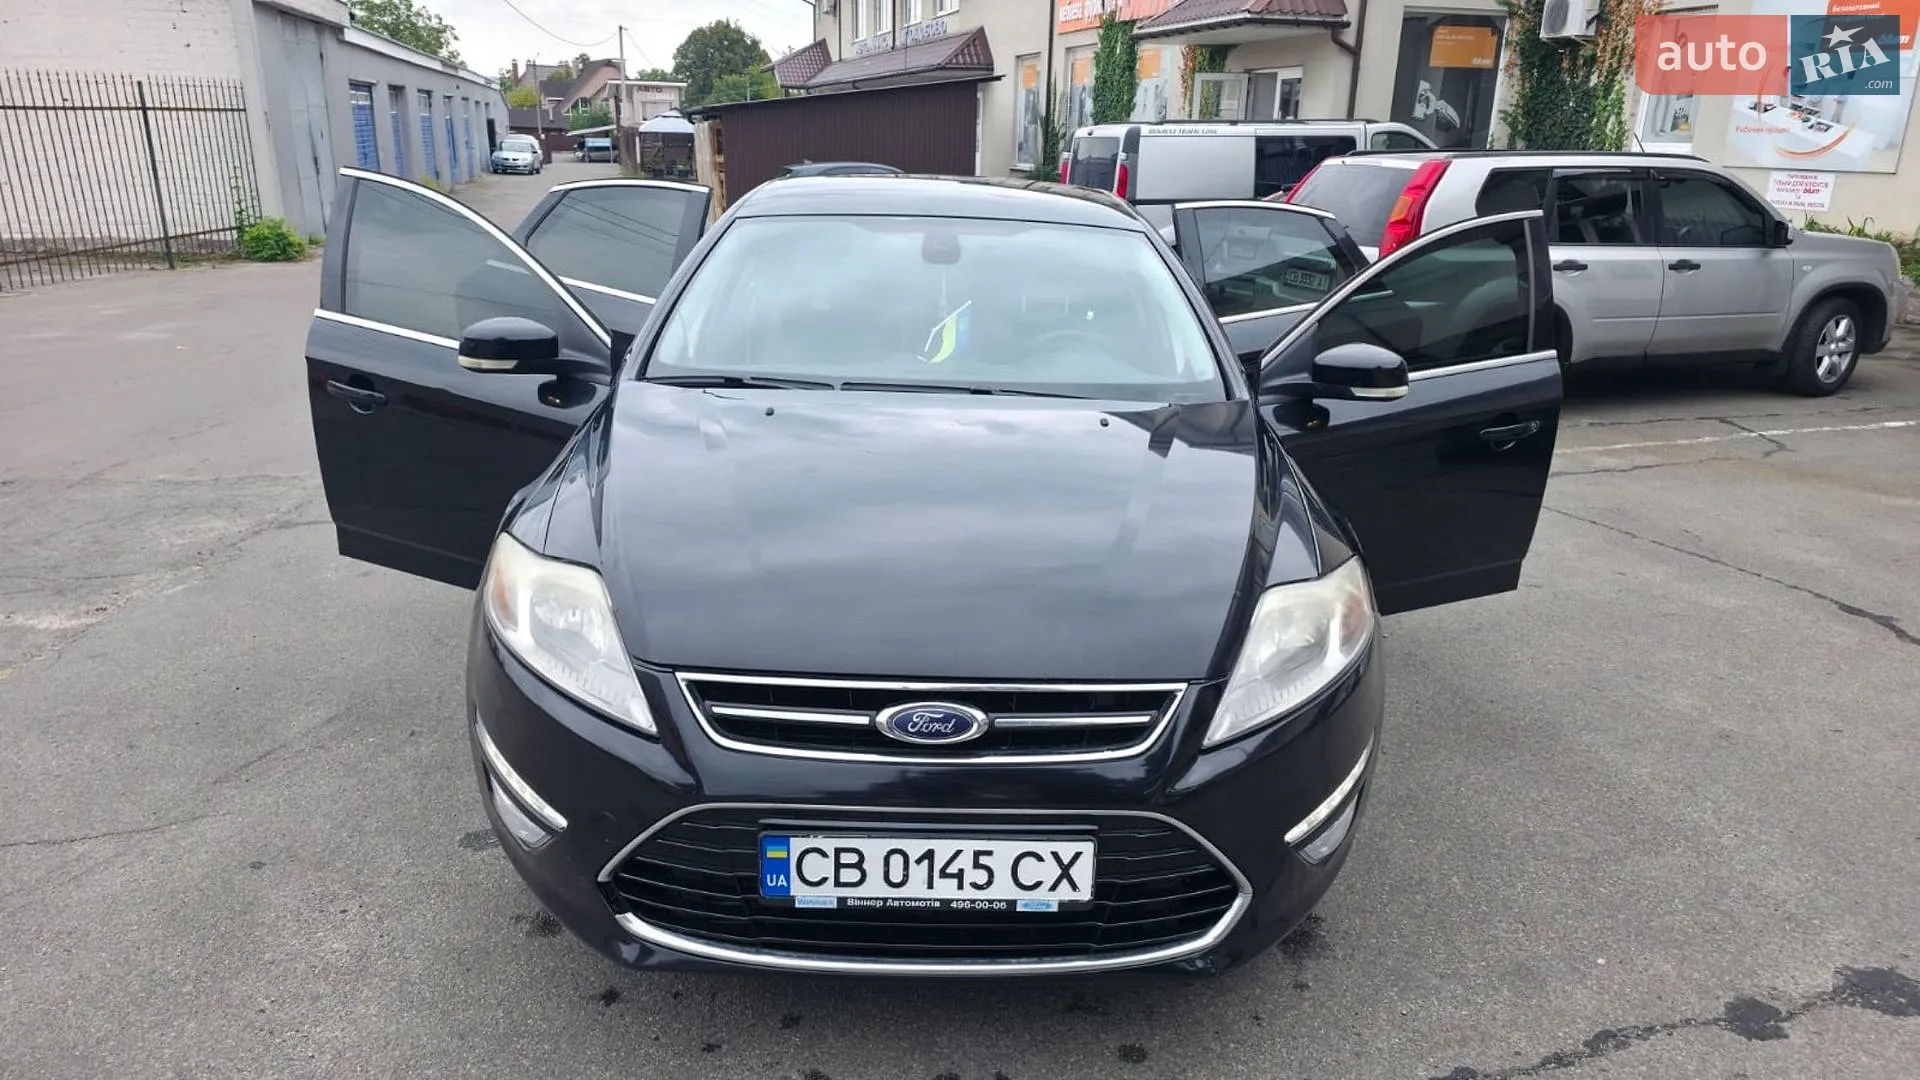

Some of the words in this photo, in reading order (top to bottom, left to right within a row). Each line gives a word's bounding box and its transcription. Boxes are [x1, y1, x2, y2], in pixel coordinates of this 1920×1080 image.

[907, 712, 956, 733] Ford
[767, 874, 787, 887] UA
[795, 847, 867, 888] CB
[882, 848, 995, 891] 0145
[1010, 851, 1084, 892] CX
[847, 898, 883, 908] Віннер
